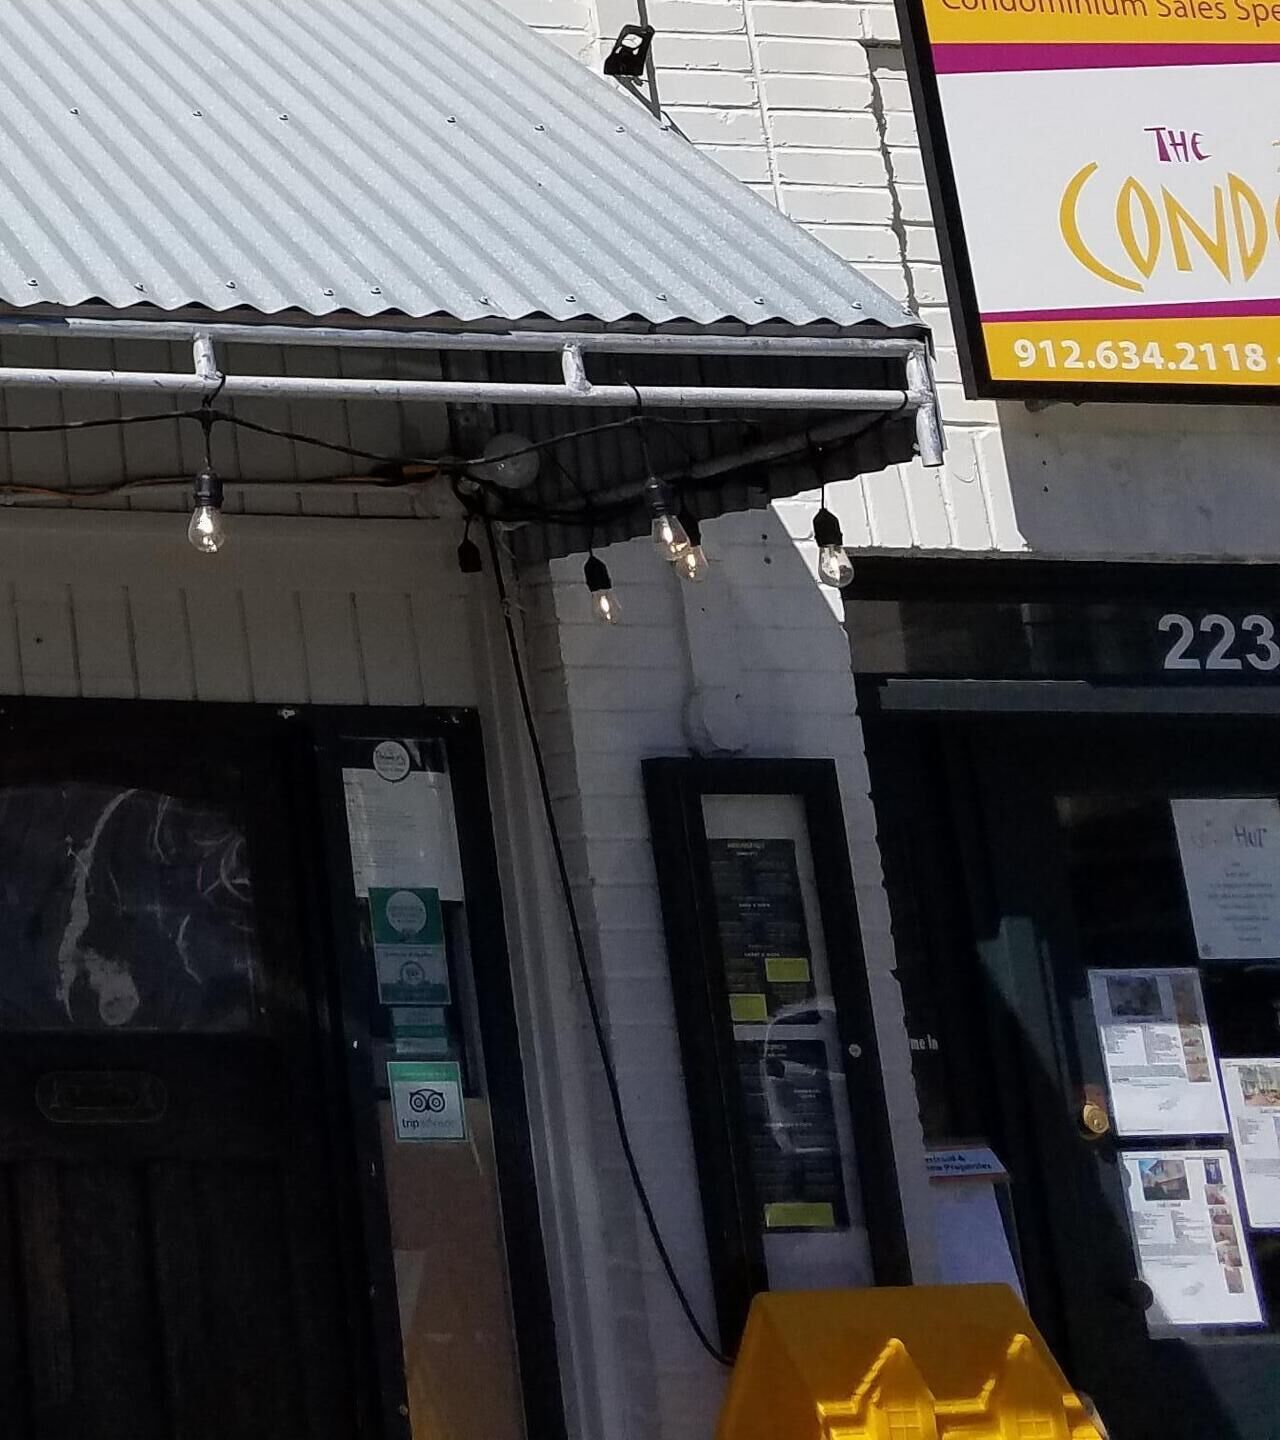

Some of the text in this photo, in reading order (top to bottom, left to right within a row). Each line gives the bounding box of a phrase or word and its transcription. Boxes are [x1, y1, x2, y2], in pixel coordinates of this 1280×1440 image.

[1143, 126, 1212, 163] THE
[1059, 161, 1280, 293] COND
[1014, 338, 1268, 373] 912.634.2118
[1158, 613, 1280, 671] 223
